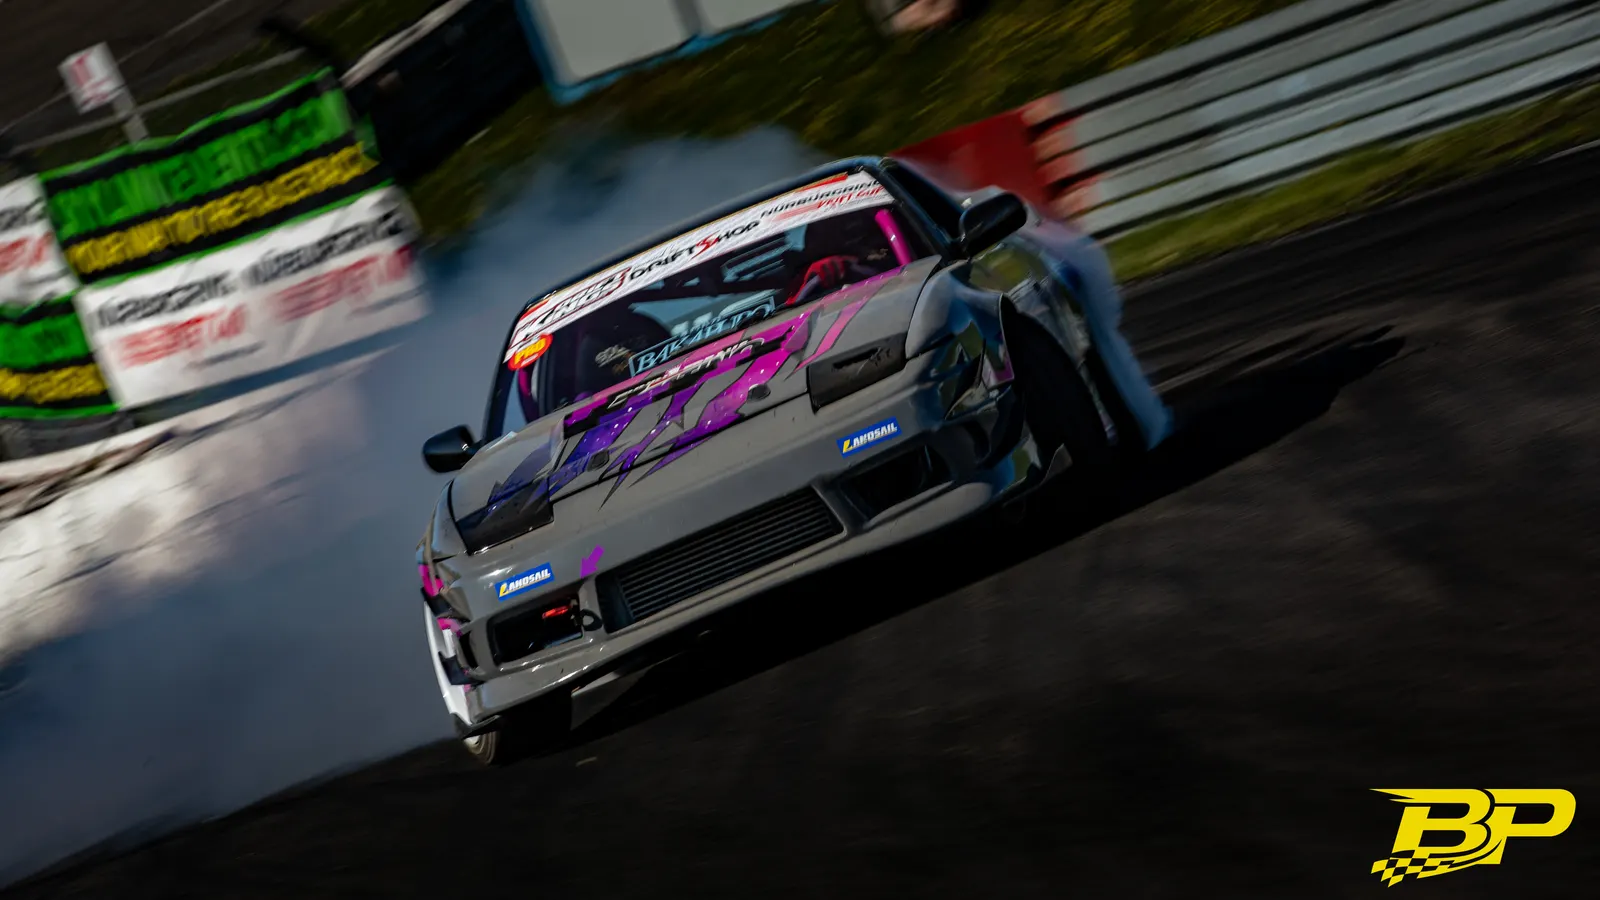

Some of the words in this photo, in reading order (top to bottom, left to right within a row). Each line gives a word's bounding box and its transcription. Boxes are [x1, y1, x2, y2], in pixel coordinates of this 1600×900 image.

[630, 220, 760, 280] DRIFTSHOP
[514, 337, 547, 366] PRO
[842, 422, 898, 454] LANDSAIL
[498, 568, 551, 598] LANDSAIL
